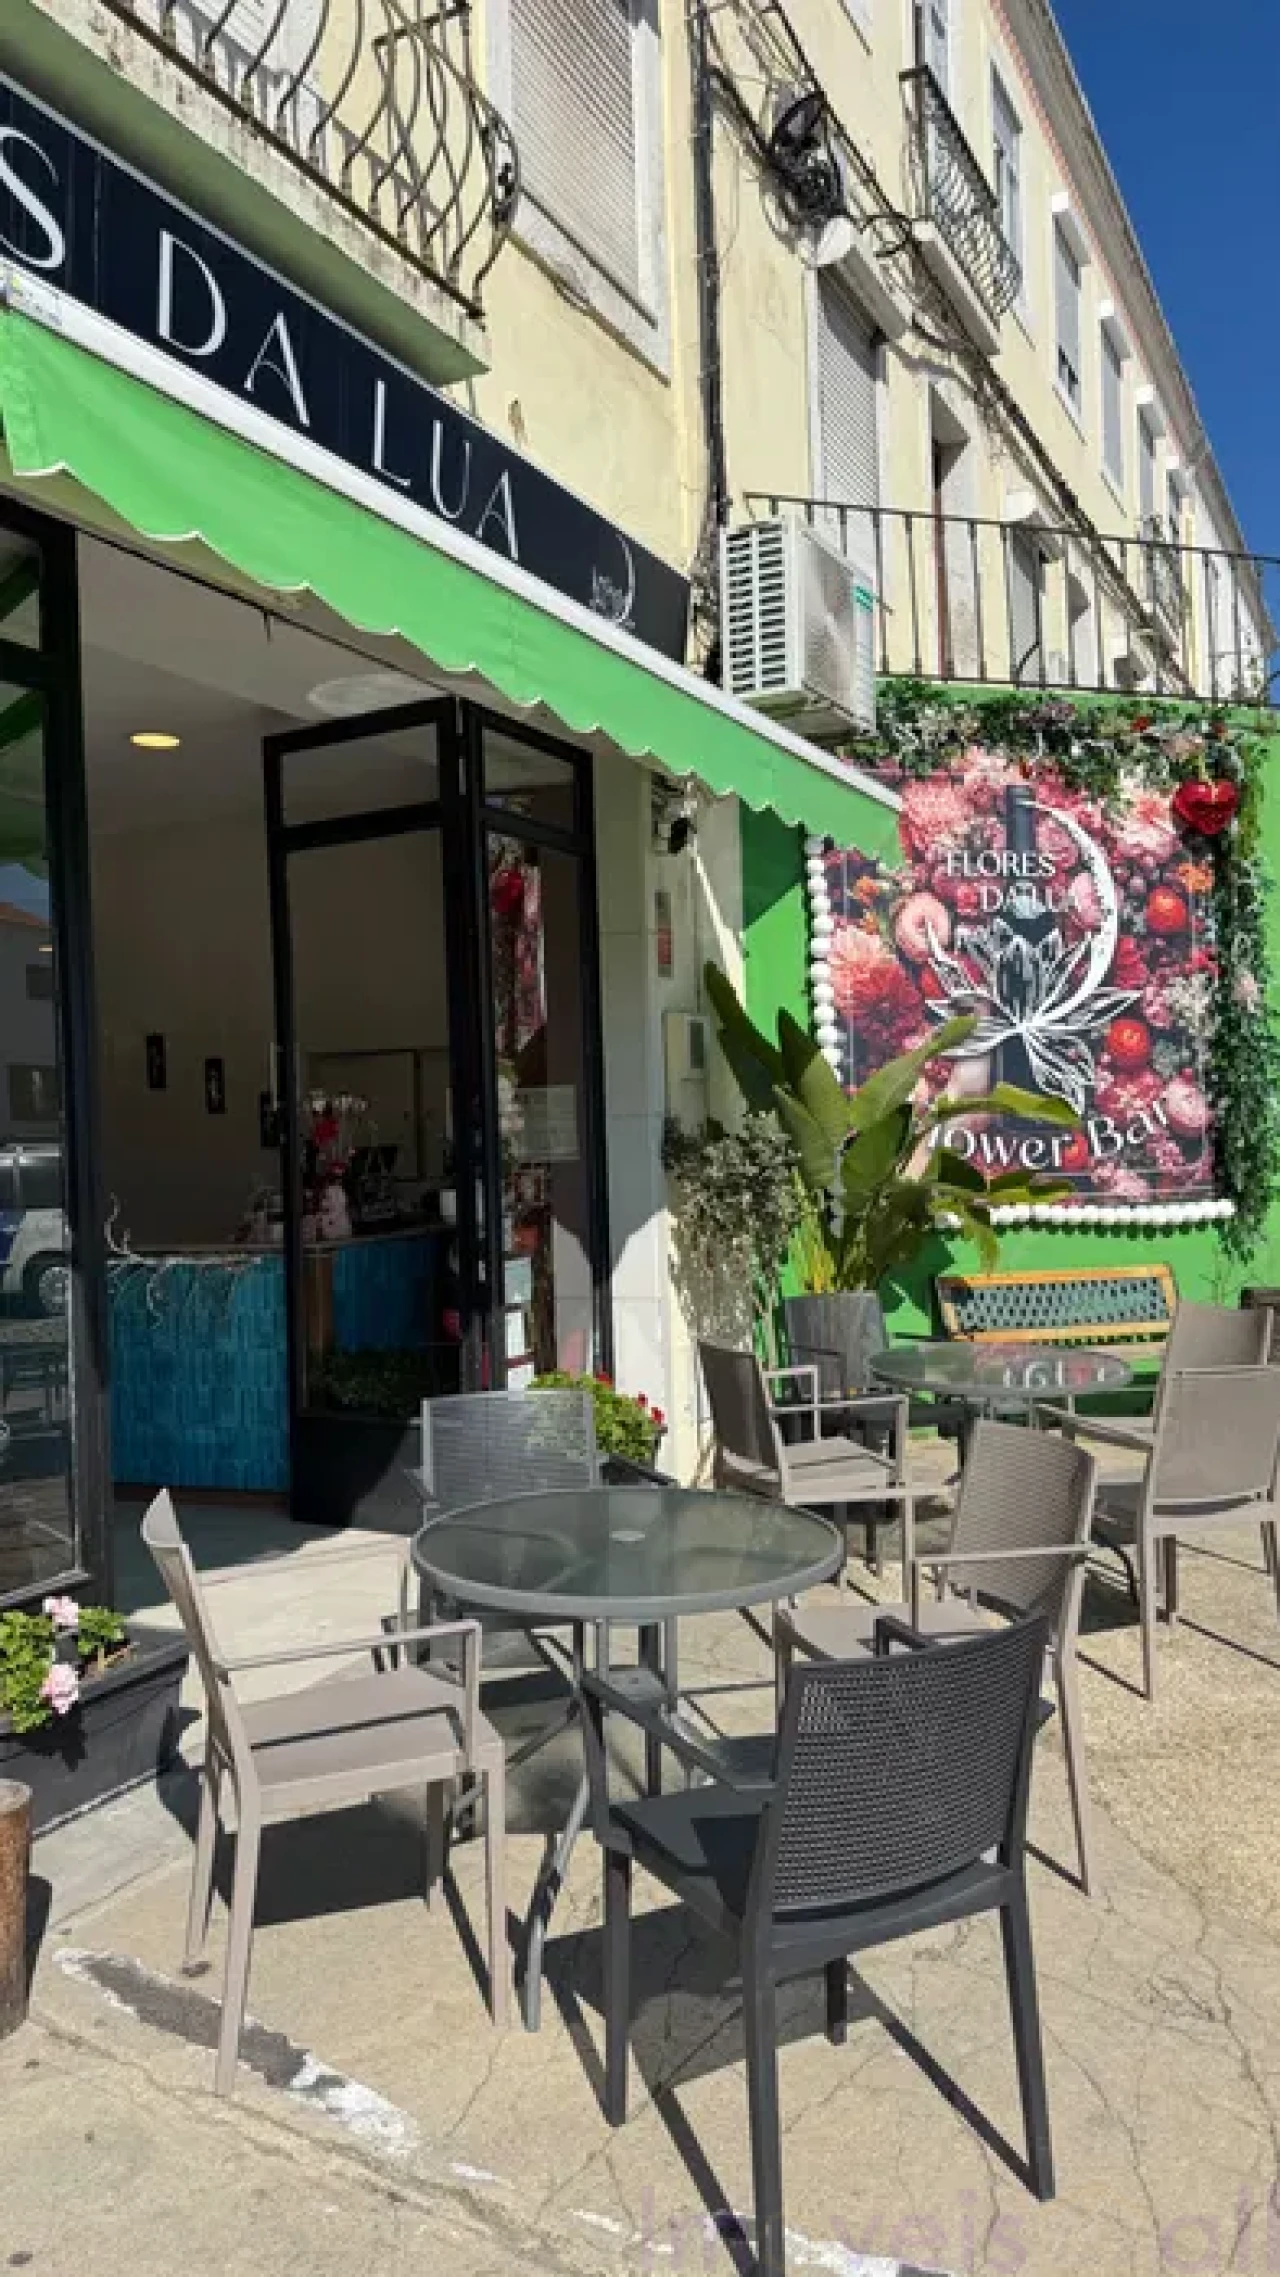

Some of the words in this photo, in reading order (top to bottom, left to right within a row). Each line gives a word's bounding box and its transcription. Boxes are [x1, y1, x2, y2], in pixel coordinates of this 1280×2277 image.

[156, 229, 311, 427] DA
[372, 379, 520, 563] LUA
[946, 850, 1056, 877] FLORES
